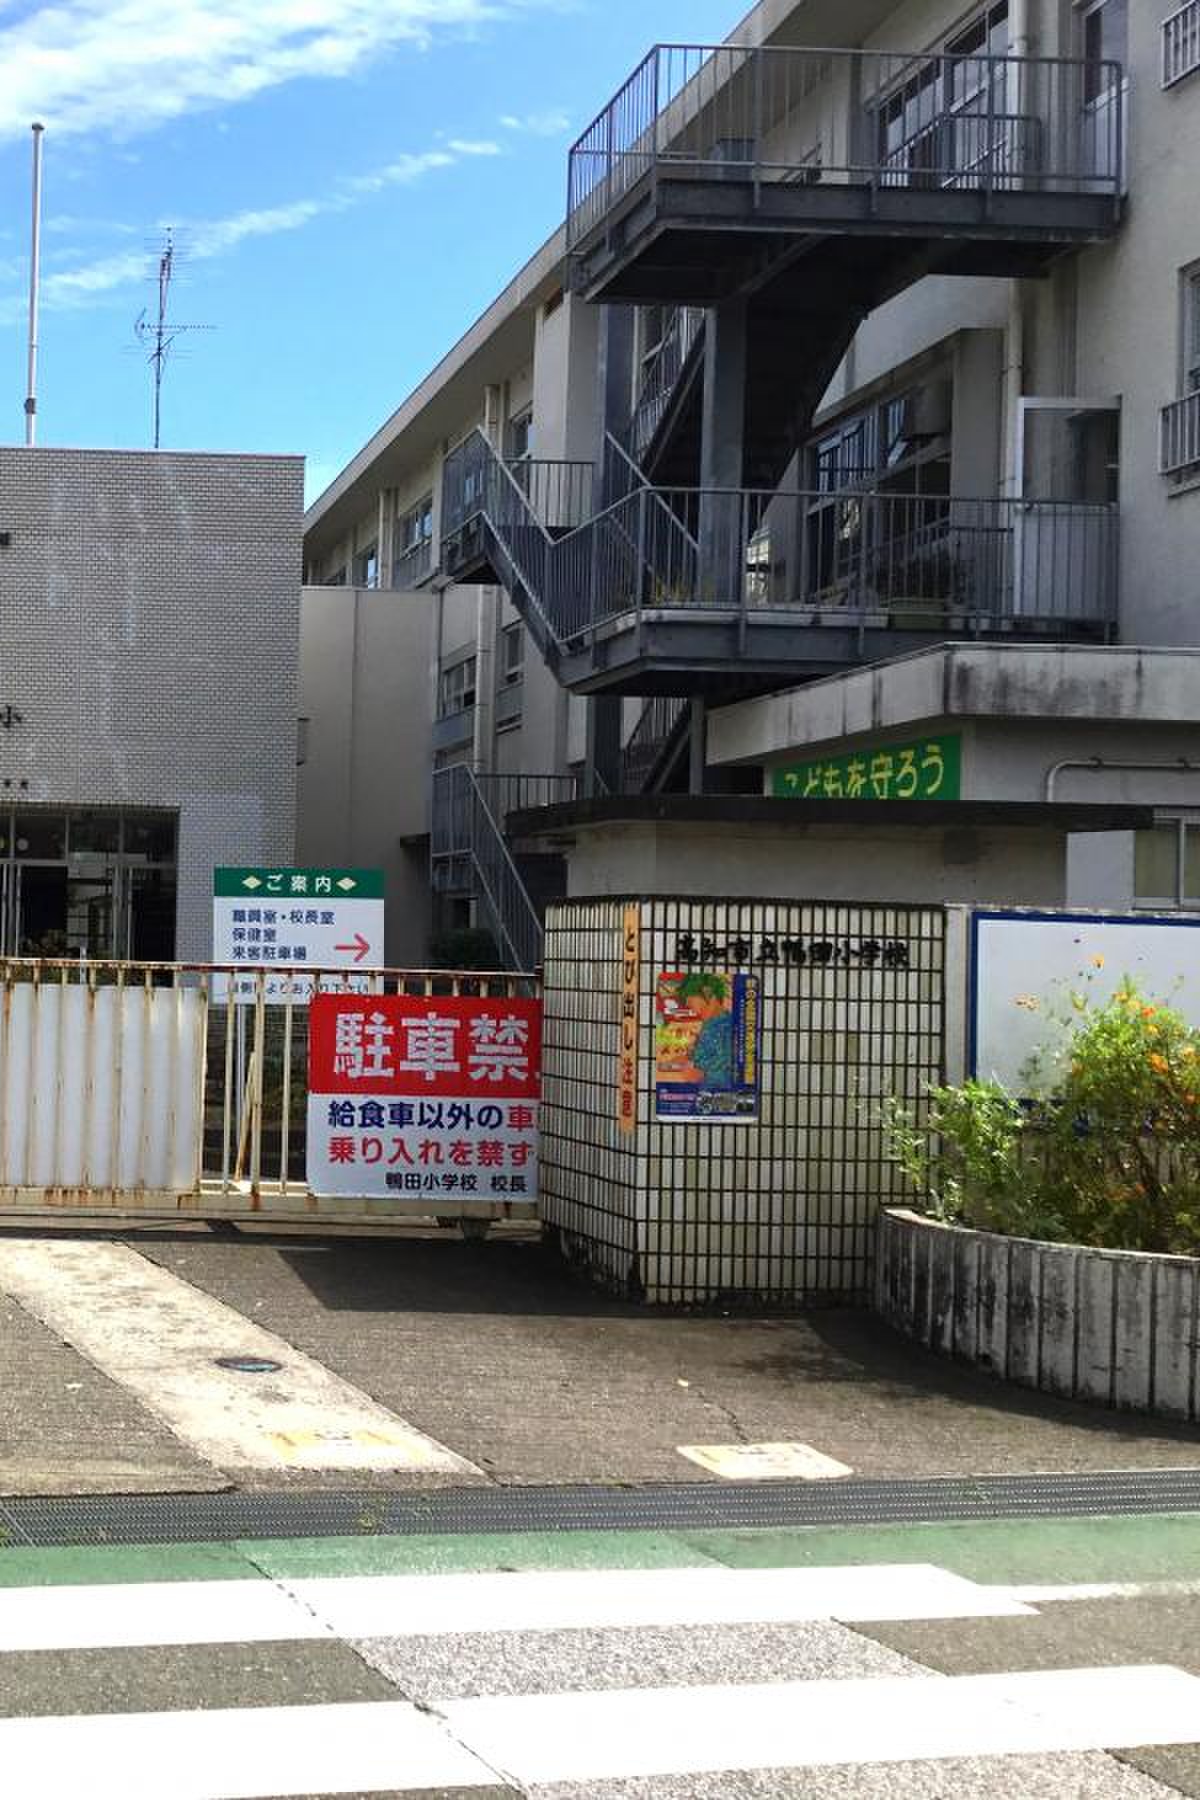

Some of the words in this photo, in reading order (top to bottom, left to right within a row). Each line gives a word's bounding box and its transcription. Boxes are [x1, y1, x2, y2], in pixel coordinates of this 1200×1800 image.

[266, 873, 332, 893] ご案内
[231, 927, 278, 943] 保健室
[231, 945, 307, 961] 来客駐車場
[332, 1011, 540, 1082] 駐車禁
[327, 1100, 540, 1132] 給食車以外の車
[385, 1172, 479, 1192] 鴨田小学校
[489, 1174, 529, 1193] 校長
